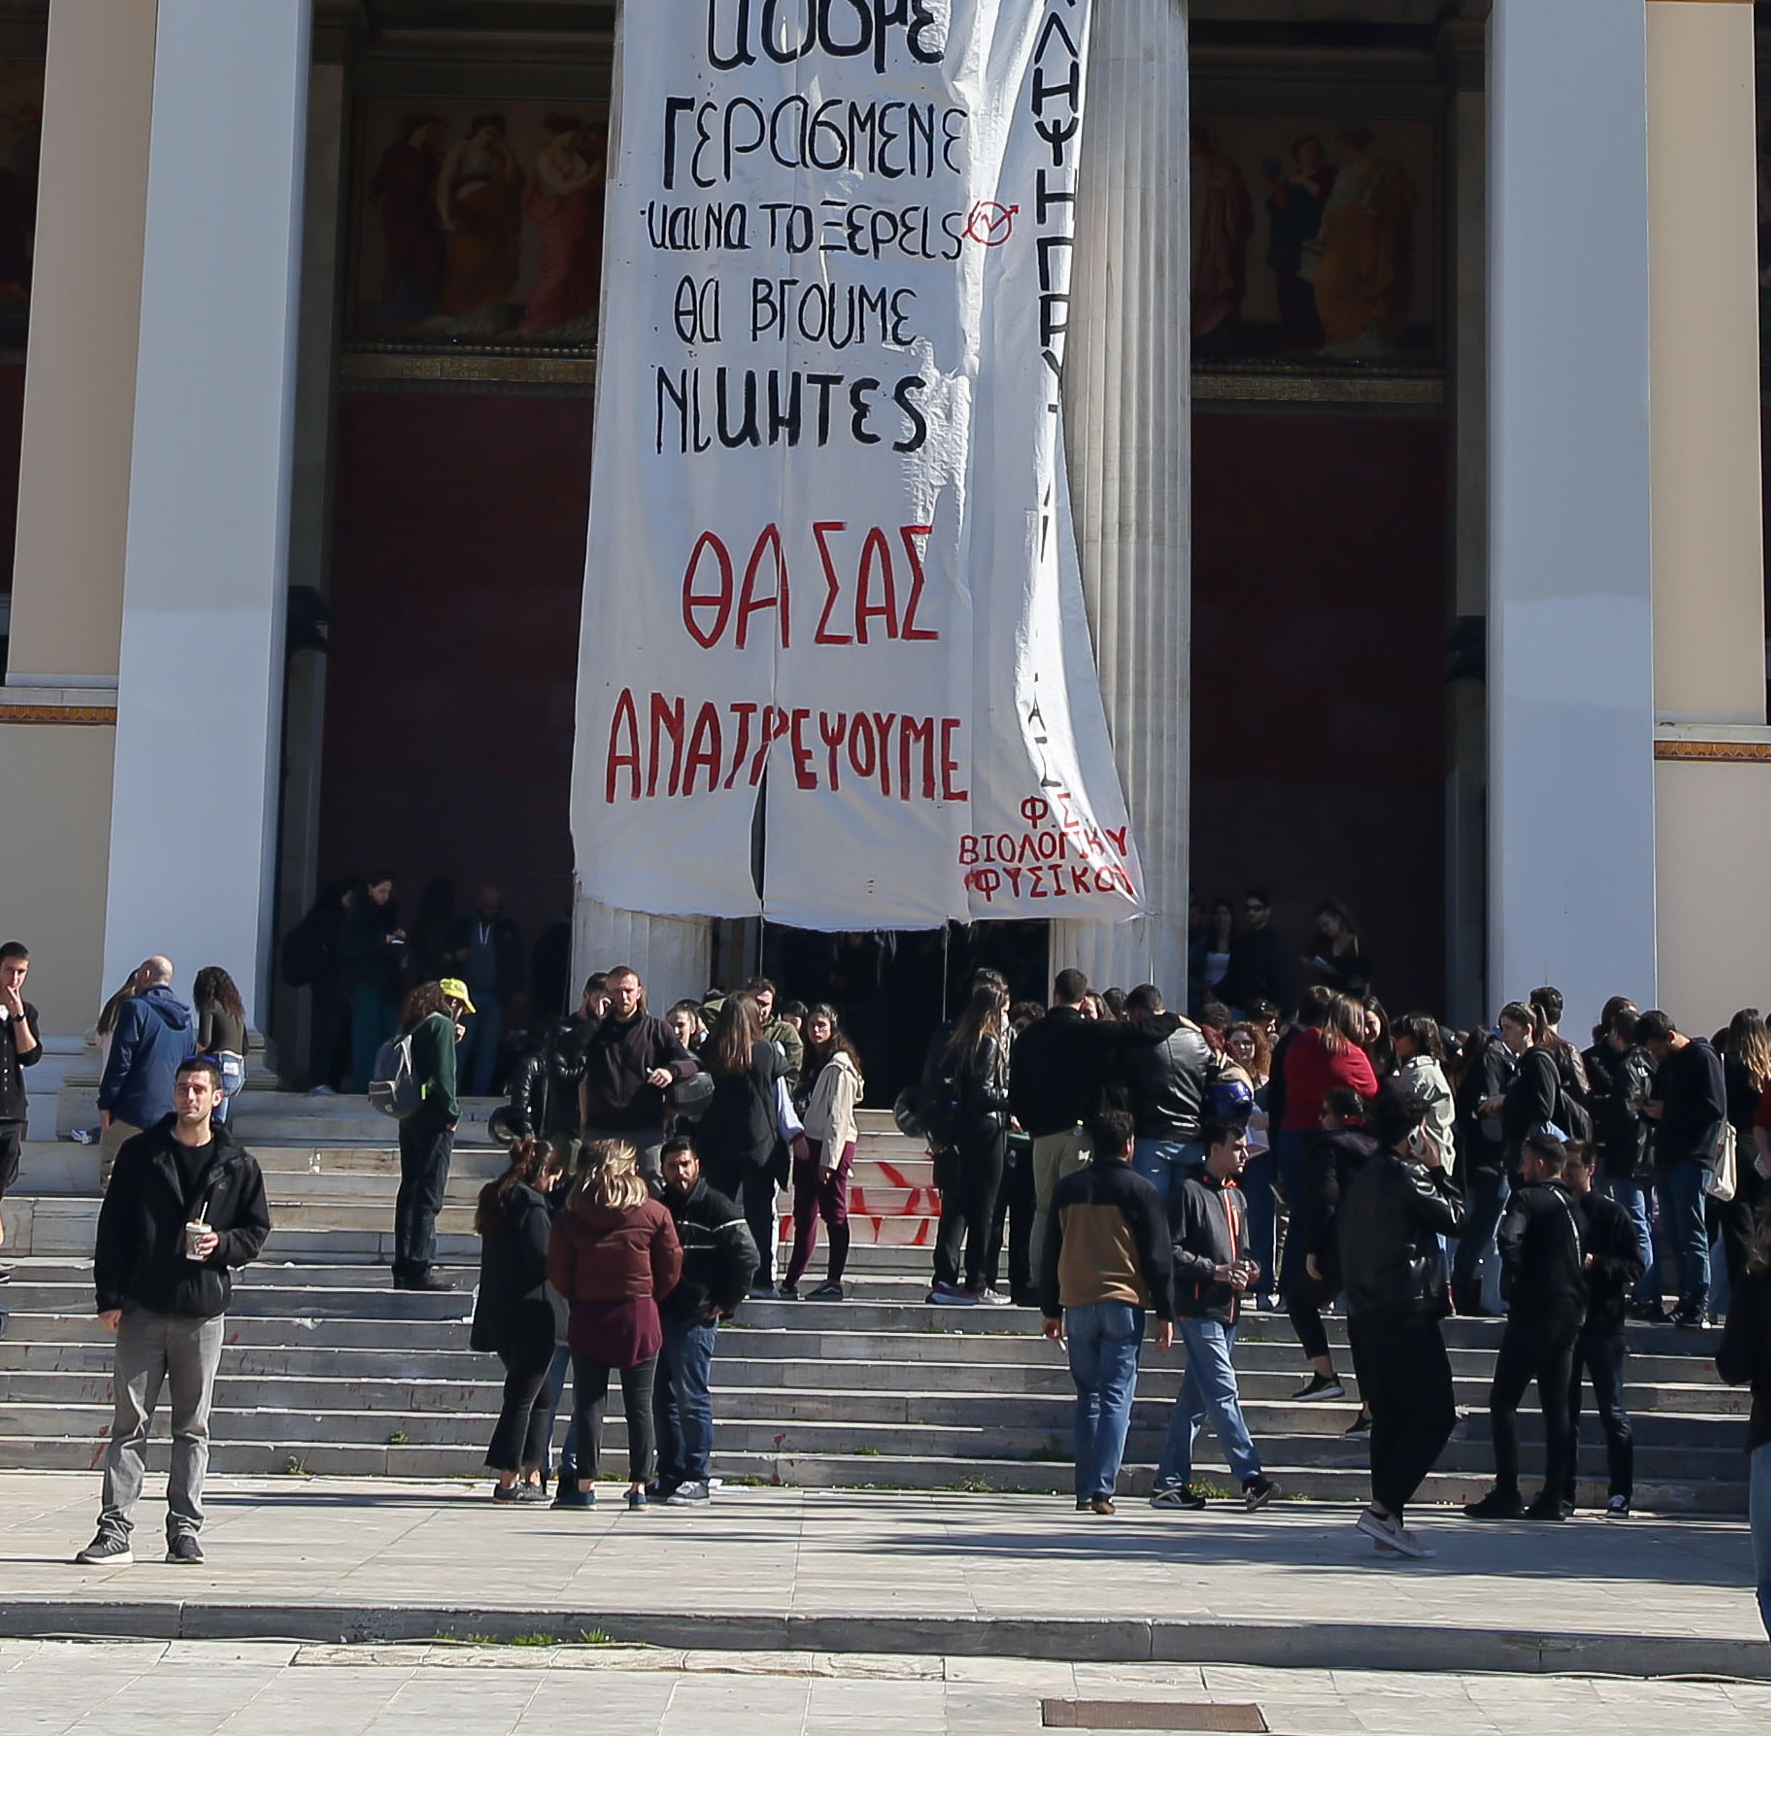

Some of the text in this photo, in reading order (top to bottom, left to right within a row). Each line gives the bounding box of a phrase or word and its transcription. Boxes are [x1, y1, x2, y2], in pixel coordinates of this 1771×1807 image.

[682, 521, 941, 649] ΘΑ ΣΑΣ
[605, 687, 969, 804] ΑΝΑΤΡΕΨΟΥΜΕ
